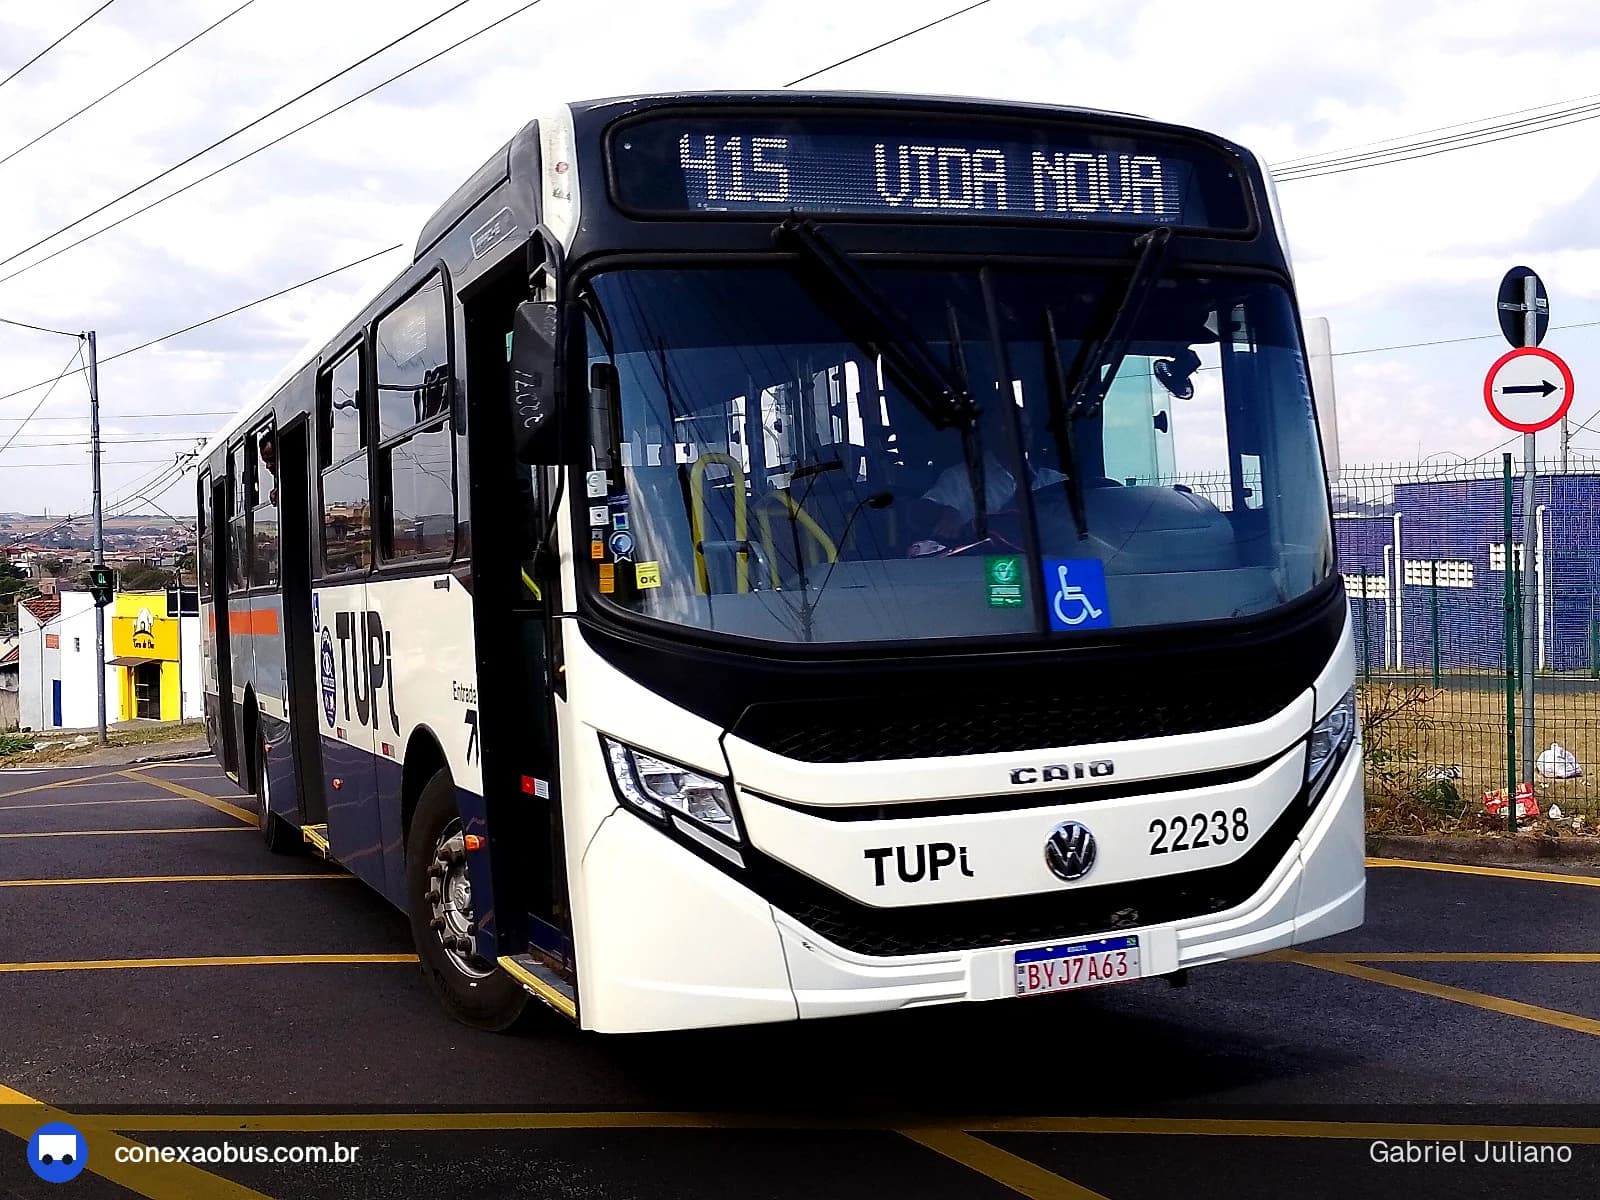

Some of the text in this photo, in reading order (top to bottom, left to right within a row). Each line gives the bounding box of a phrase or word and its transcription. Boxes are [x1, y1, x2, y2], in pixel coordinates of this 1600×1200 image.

[678, 132, 1166, 215] 415 VIDA NOVA
[639, 574, 658, 584] OK
[1010, 759, 1115, 785] CAIO
[1148, 806, 1249, 856] 22238
[1027, 951, 1128, 991] BYJ7A63
